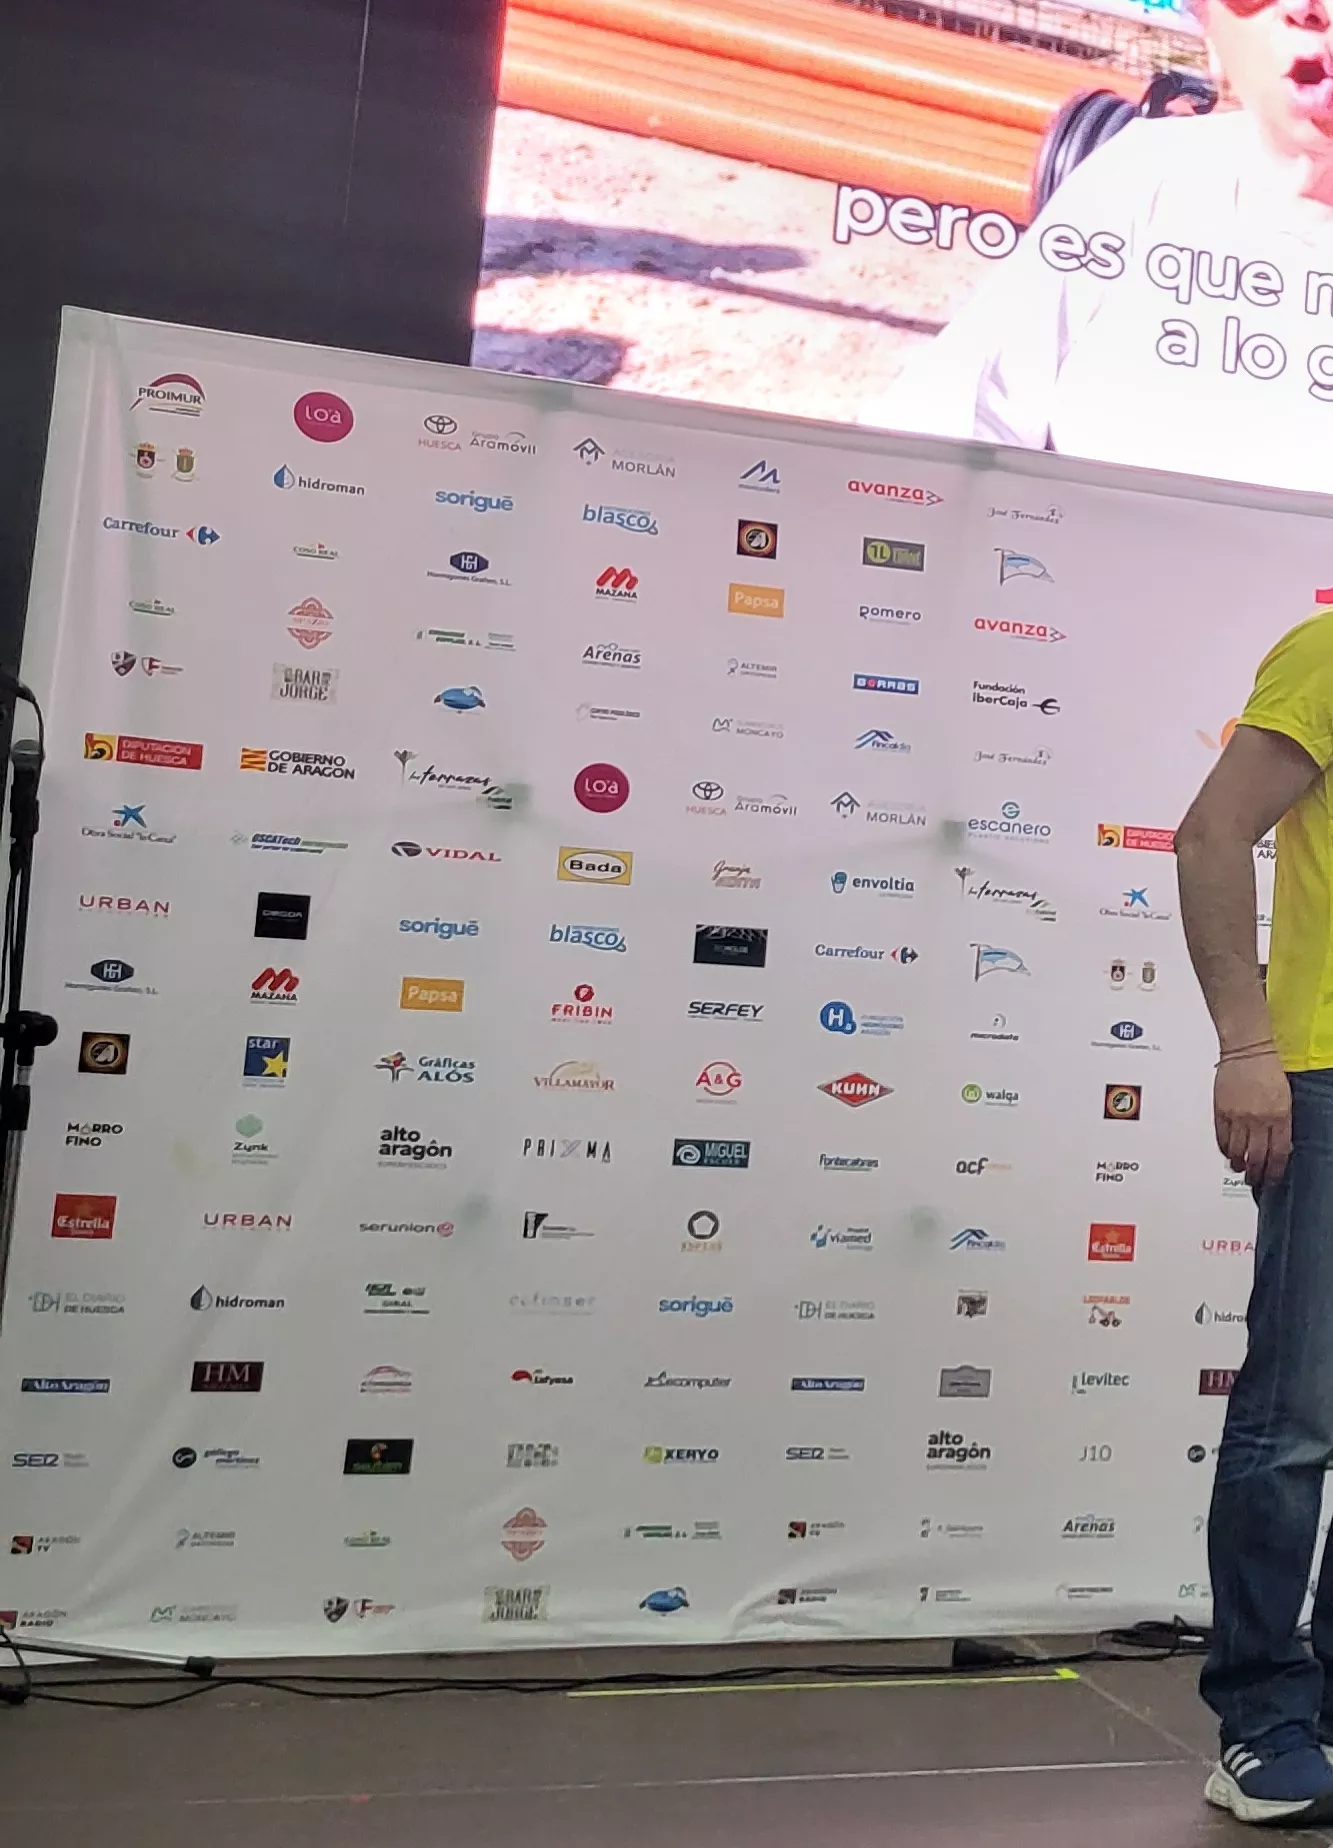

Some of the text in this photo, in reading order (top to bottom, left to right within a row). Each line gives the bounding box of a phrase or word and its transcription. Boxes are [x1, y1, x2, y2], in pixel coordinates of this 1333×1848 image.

[833, 180, 1018, 260] pero
[1039, 220, 1127, 280] es
[1145, 243, 1285, 308] que
[1156, 322, 1203, 368] a
[1222, 315, 1288, 377] lo
[138, 387, 202, 404] PROIMUR
[418, 437, 462, 451] HUESCA
[469, 437, 537, 455] Aramóvil
[298, 475, 365, 495] hidroman
[848, 480, 924, 500] avanza
[582, 504, 659, 535] blasco
[103, 517, 180, 539] Carrefour
[596, 587, 638, 599] MAZANA
[734, 591, 779, 609] Papsa
[974, 618, 1047, 637] avanza
[582, 645, 641, 664] Arenas
[973, 681, 1026, 694] Fundación
[122, 751, 137, 761] DE
[269, 751, 346, 766] GOBIERNO
[268, 762, 288, 774] DE
[968, 818, 1051, 837] escanero
[426, 847, 502, 862] VIDAL
[570, 859, 622, 874] Bada
[852, 876, 915, 891] envoltia
[79, 895, 170, 914] URBAN
[549, 924, 627, 952] blasco
[815, 944, 885, 961] Carrefour
[408, 986, 457, 1004] Papsa
[552, 1004, 612, 1018] FRIBIN
[687, 1001, 764, 1019] SERFEY
[249, 1037, 278, 1050] star
[418, 1055, 476, 1070] Gráficas
[417, 1067, 475, 1083] ALÓS
[832, 1082, 881, 1096] KUHN
[65, 1136, 102, 1147] FINO
[380, 1125, 421, 1142] alto
[705, 1142, 747, 1160] MIGUEL
[57, 1215, 111, 1231] Estrella
[203, 1213, 293, 1228] URBAN
[360, 1221, 435, 1234] serunion
[1202, 1239, 1254, 1251] URBA
[215, 1295, 285, 1310] hidroman
[1214, 1310, 1247, 1323] hidro
[204, 1363, 250, 1383] HM
[1082, 1372, 1129, 1387] Levitec
[928, 1430, 963, 1446] alto
[926, 1442, 991, 1462] aragón
[1079, 1446, 1112, 1462] J10
[1062, 1518, 1115, 1533] Arenas
